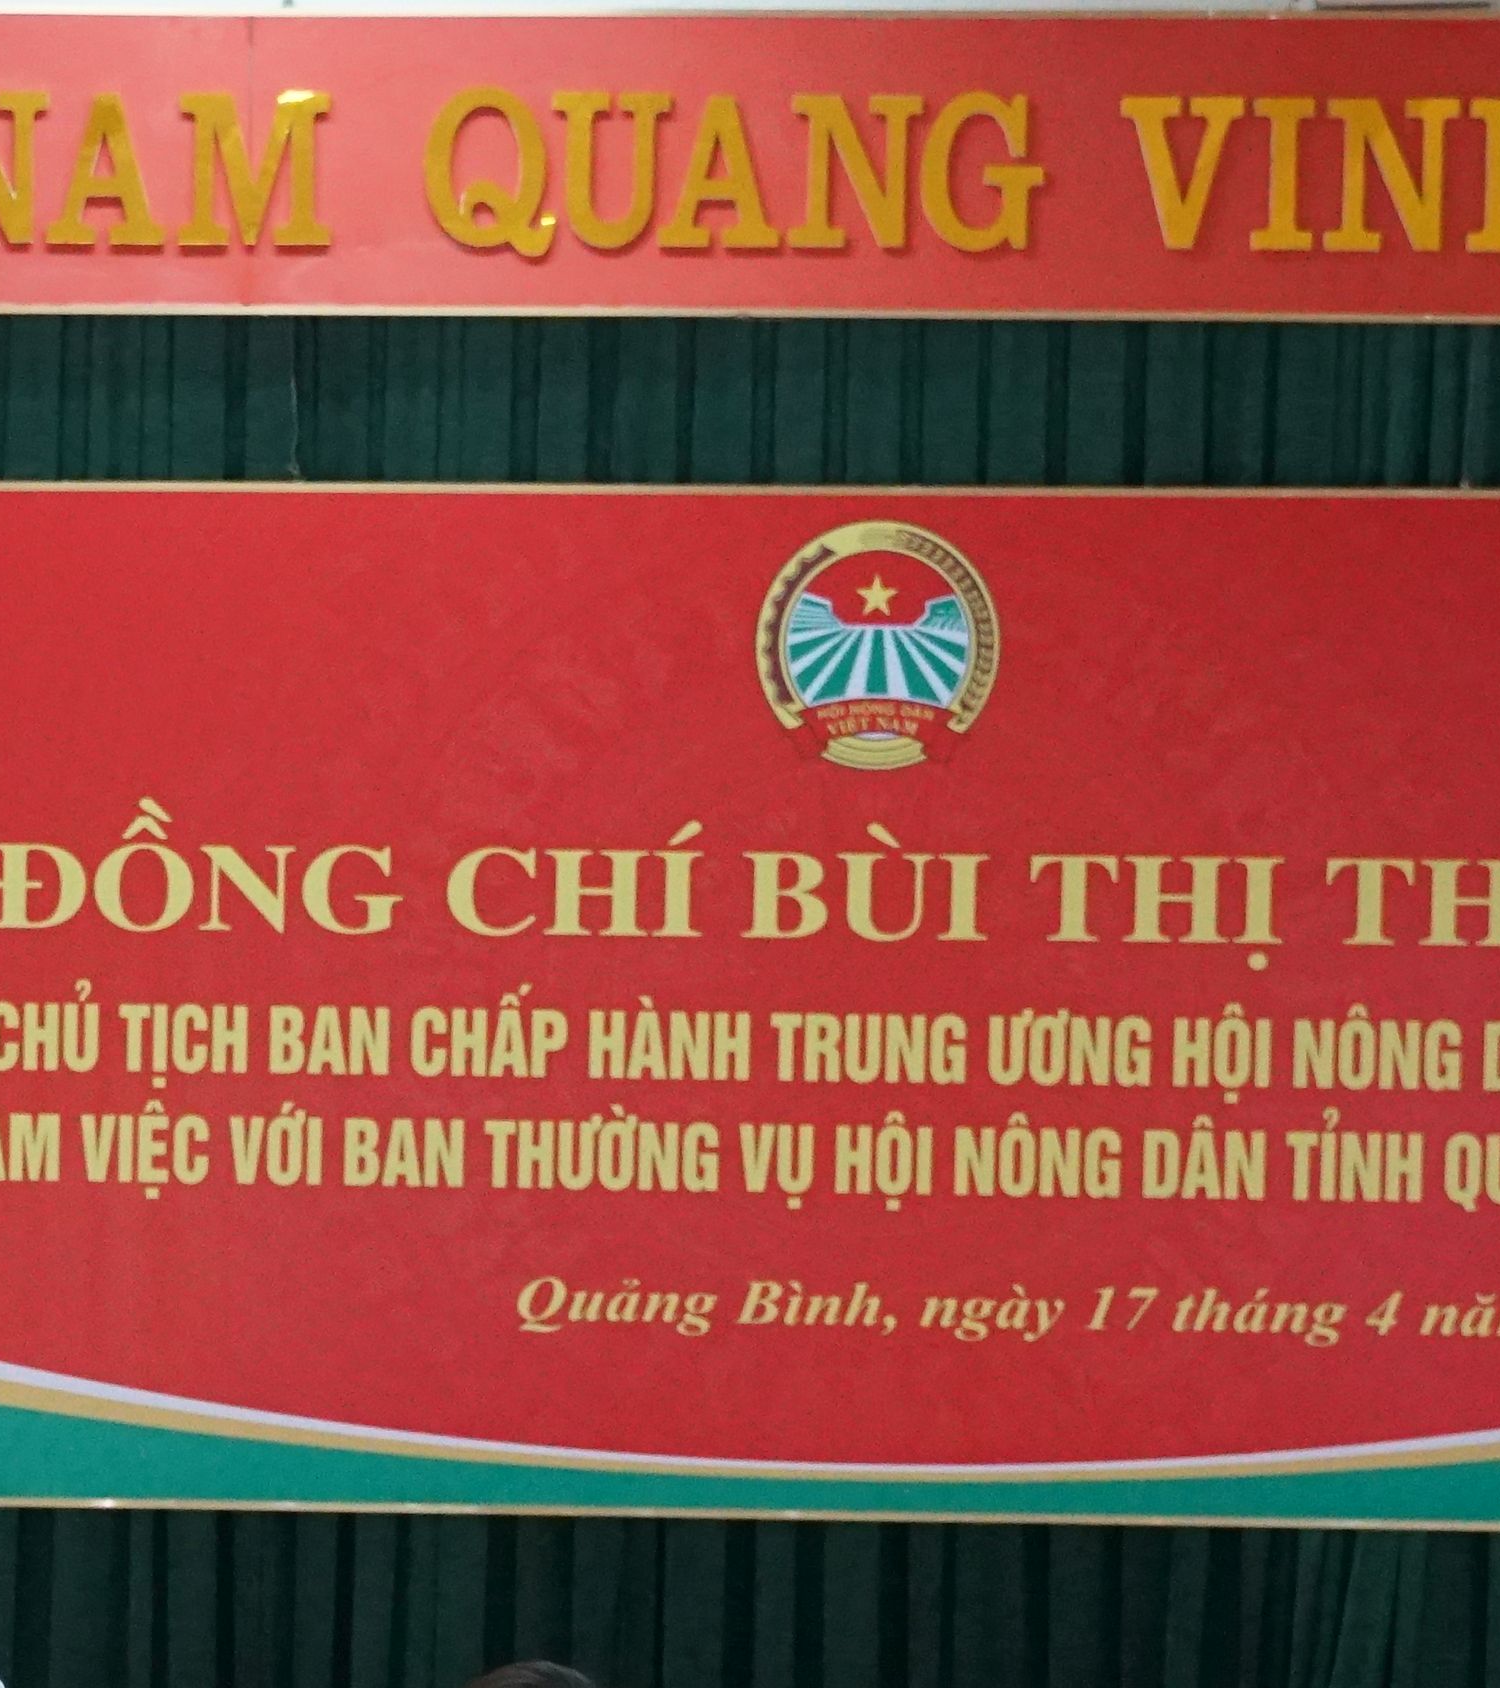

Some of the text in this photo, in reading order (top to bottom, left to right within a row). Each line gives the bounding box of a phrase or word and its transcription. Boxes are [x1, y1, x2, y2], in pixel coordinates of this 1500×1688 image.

[421, 84, 1045, 260] QUANG
[447, 820, 702, 937] CHÍ
[743, 822, 988, 942] BÙI
[1030, 854, 1283, 971] THỊ
[119, 1003, 249, 1088] TỊCH
[269, 1005, 391, 1075] BAN
[411, 983, 568, 1078] CHẤP
[588, 995, 751, 1081] HÀNH
[770, 1012, 968, 1085] TRUNG
[988, 1008, 1152, 1087] ƯƠNG
[1172, 1002, 1272, 1104] HỘI
[1293, 1004, 1462, 1091] NÔNG
[80, 1099, 210, 1200] VIỆC
[229, 1101, 323, 1186] VỚI
[343, 1117, 465, 1188] BAN
[484, 1104, 719, 1192] THƯỜNG
[739, 1123, 814, 1209] VỤ
[835, 1110, 933, 1211] HỘI
[954, 1112, 1121, 1198] NÔNG
[1142, 1115, 1267, 1200] DÂN
[1285, 1107, 1424, 1202] TỈNH
[517, 1277, 717, 1336] Quảng
[737, 1281, 897, 1334] Bình,
[920, 1285, 1064, 1341] ngày
[1088, 1287, 1158, 1329] 17
[1173, 1288, 1346, 1345] tháng
[1366, 1292, 1402, 1335] 4
